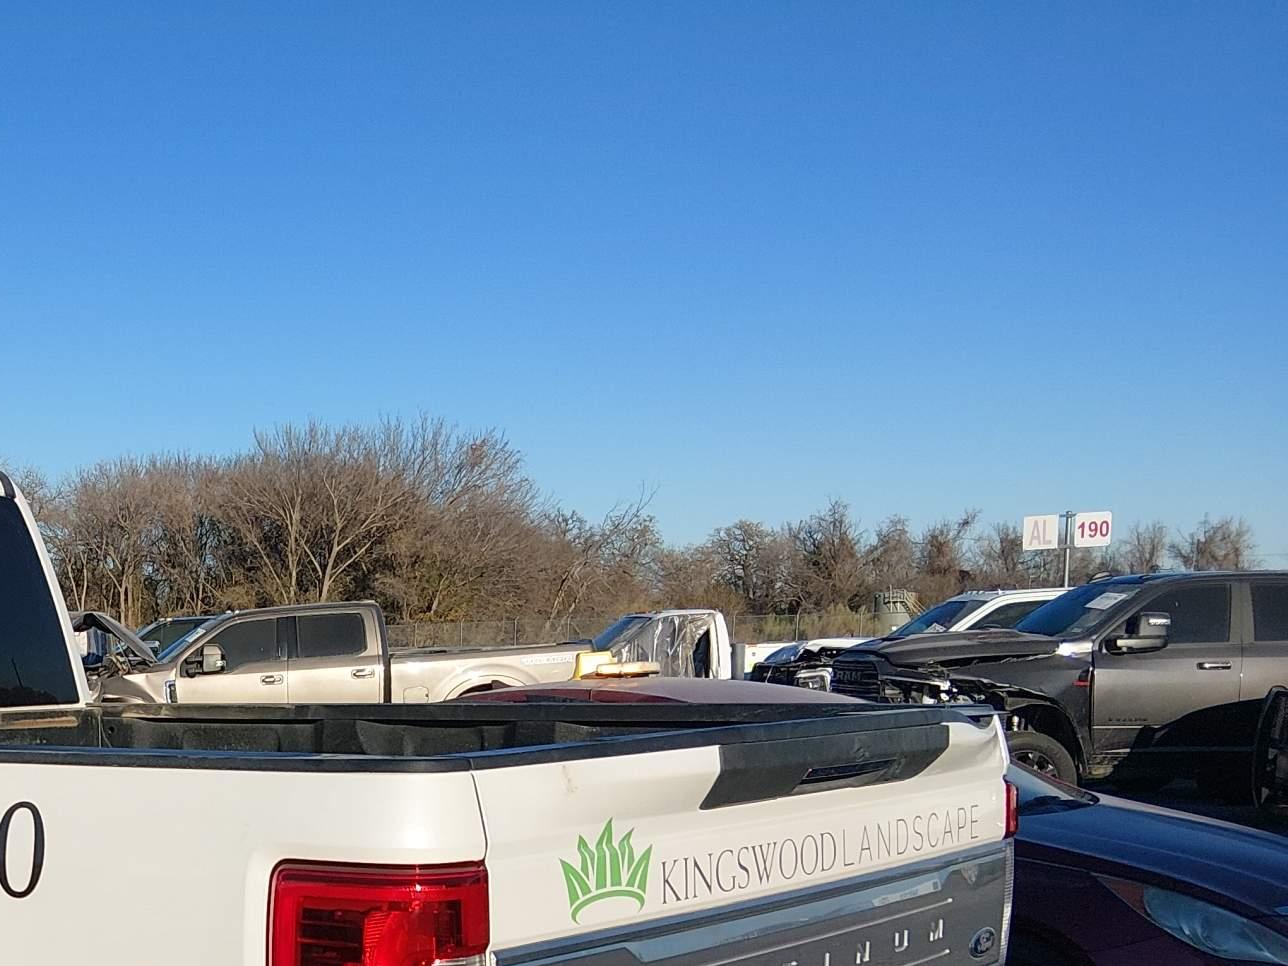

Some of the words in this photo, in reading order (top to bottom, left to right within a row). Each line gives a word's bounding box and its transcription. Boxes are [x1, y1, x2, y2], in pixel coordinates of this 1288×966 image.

[1029, 520, 1052, 545] AL
[1077, 520, 1110, 539] 190
[660, 831, 837, 905] KINGSWOOD
[841, 804, 980, 867] LANDSCAPE
